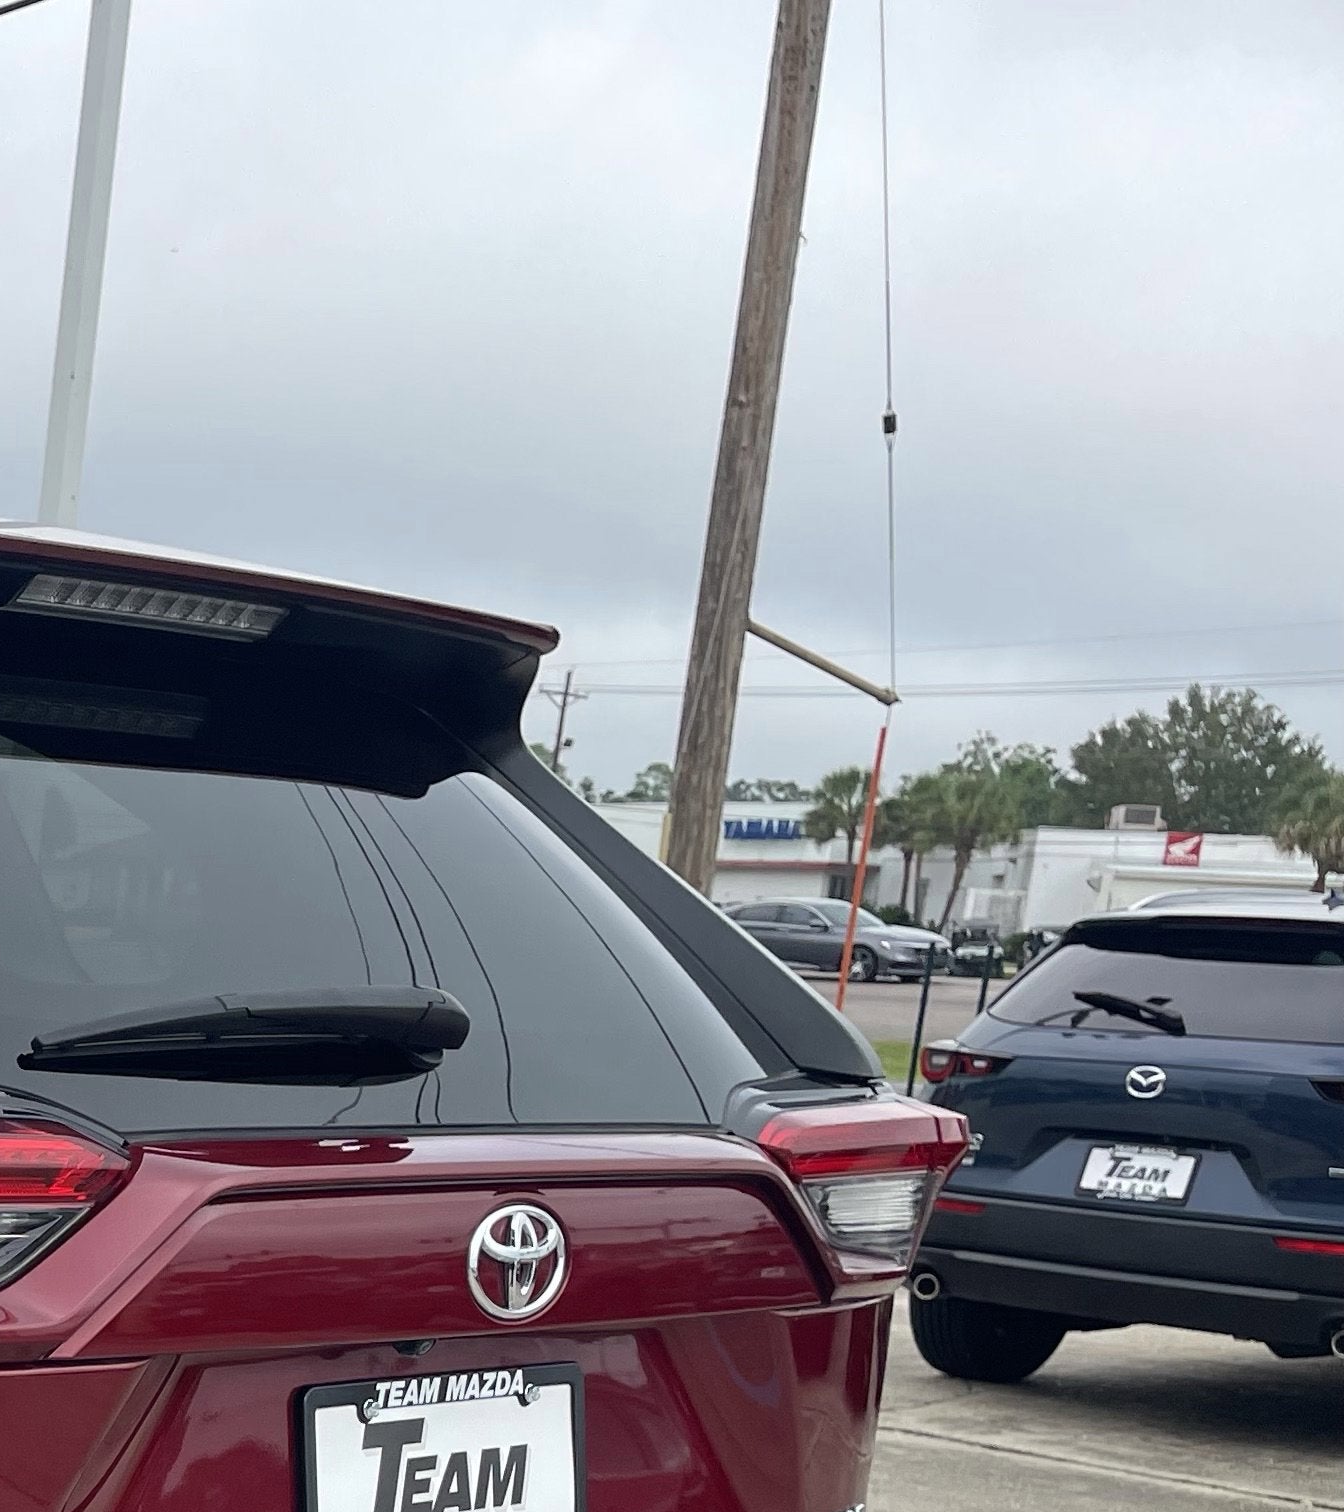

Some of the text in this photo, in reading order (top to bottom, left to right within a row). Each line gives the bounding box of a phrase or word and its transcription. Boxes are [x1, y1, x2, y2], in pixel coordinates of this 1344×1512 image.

[1106, 1155, 1170, 1182] TEAM
[375, 1369, 524, 1408] TEAM MAZDA
